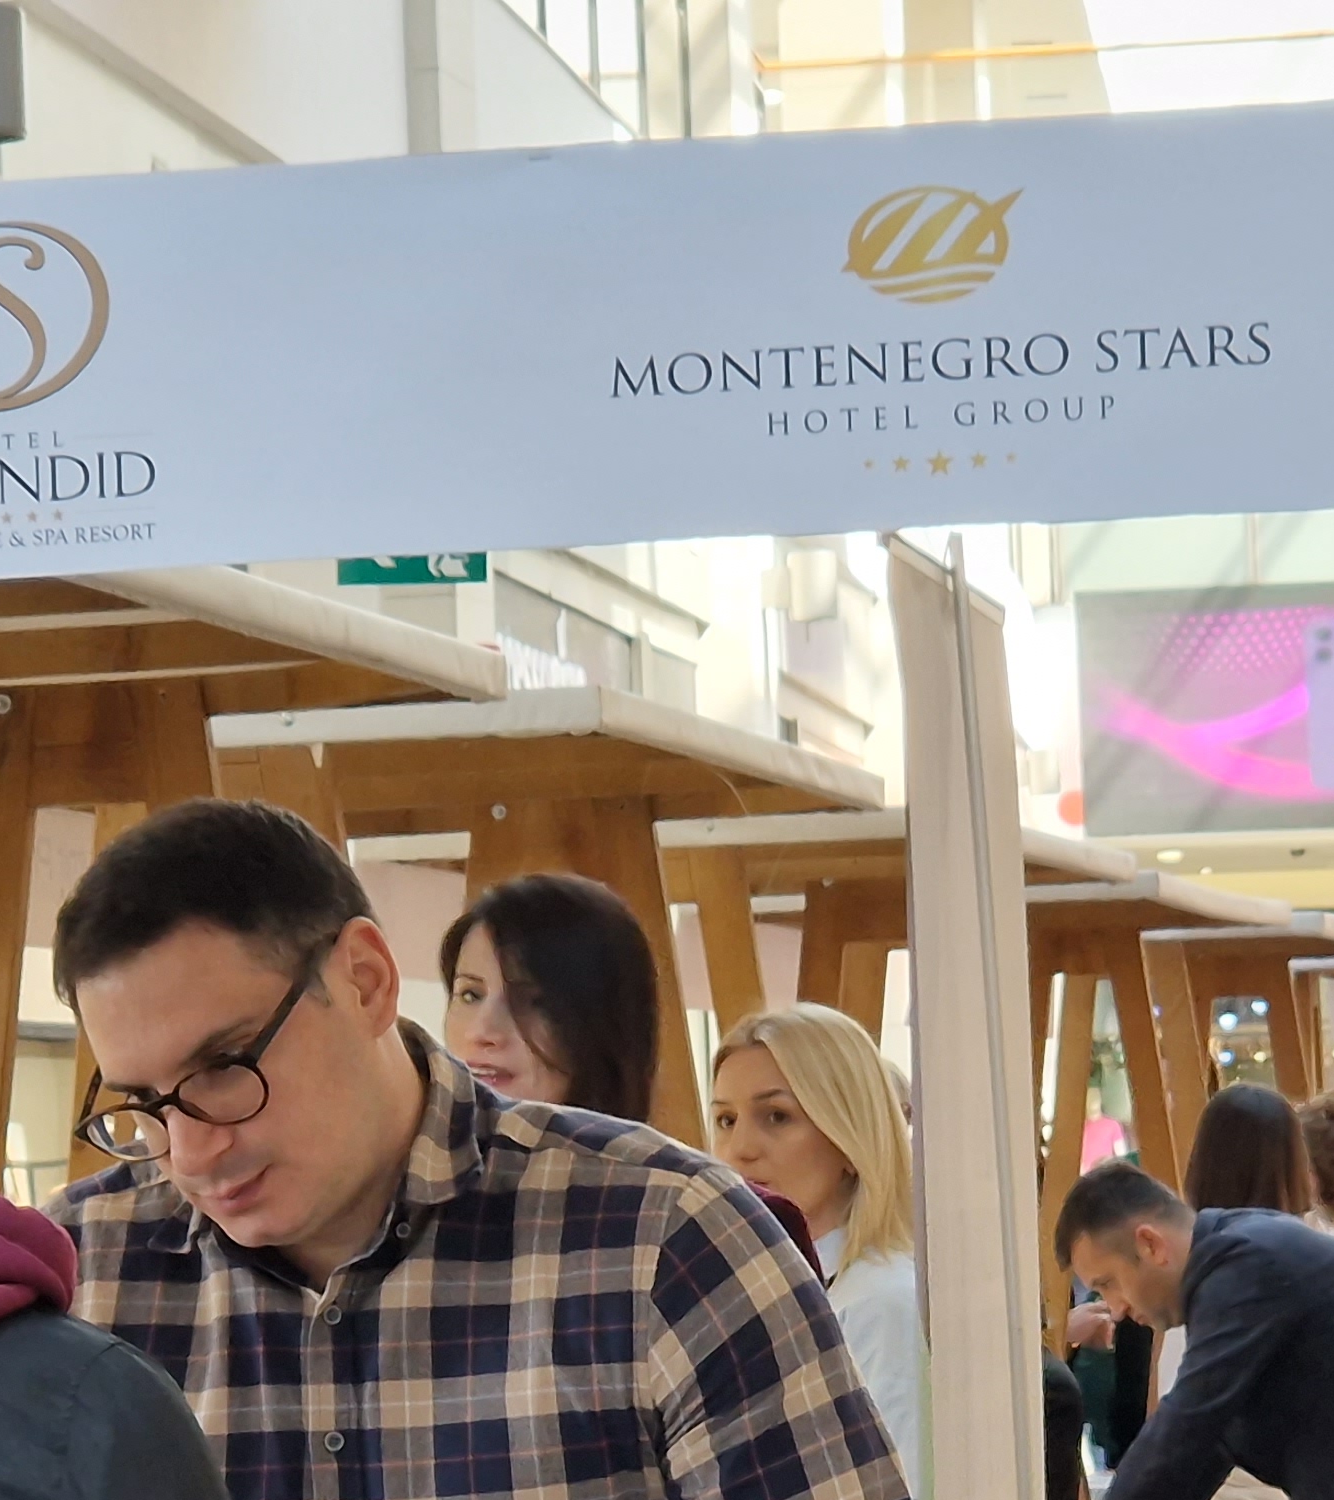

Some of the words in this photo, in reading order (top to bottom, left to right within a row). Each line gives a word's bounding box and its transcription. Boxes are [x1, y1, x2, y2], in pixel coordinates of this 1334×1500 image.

[610, 332, 1070, 399] MONTENEGRO
[1095, 321, 1272, 373] STARS
[768, 405, 919, 436] HOTEL
[953, 394, 1117, 427] GROUP
[8, 531, 26, 548] &
[32, 527, 68, 546] SPA
[75, 523, 156, 544] RESORT
